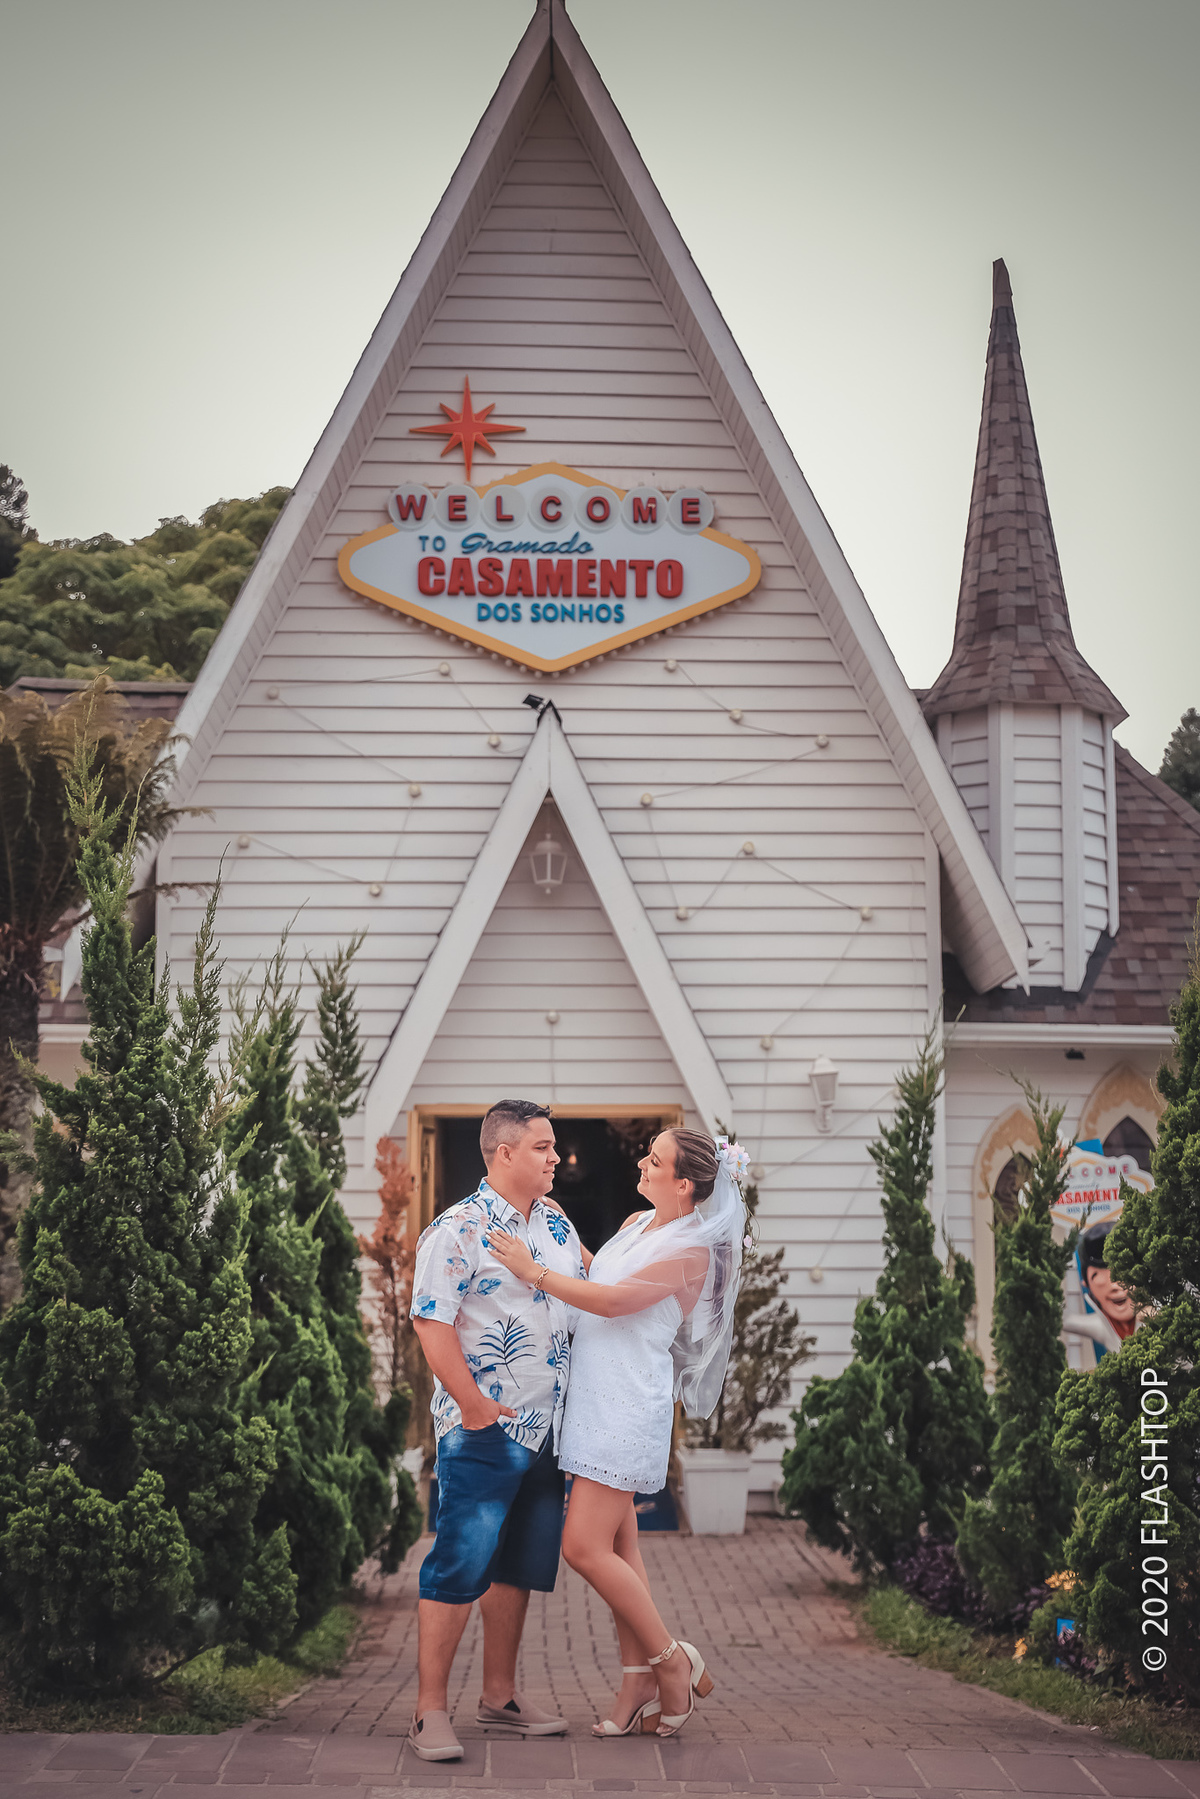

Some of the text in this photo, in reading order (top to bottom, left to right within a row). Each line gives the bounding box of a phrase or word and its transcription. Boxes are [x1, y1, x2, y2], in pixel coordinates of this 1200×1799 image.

[395, 493, 702, 525] WELCOME
[418, 531, 594, 555] TO Gramado
[417, 556, 684, 599] CASAMENTO
[476, 602, 625, 624] DOS SONHOS
[1055, 1187, 1120, 1205] ASAMENT
